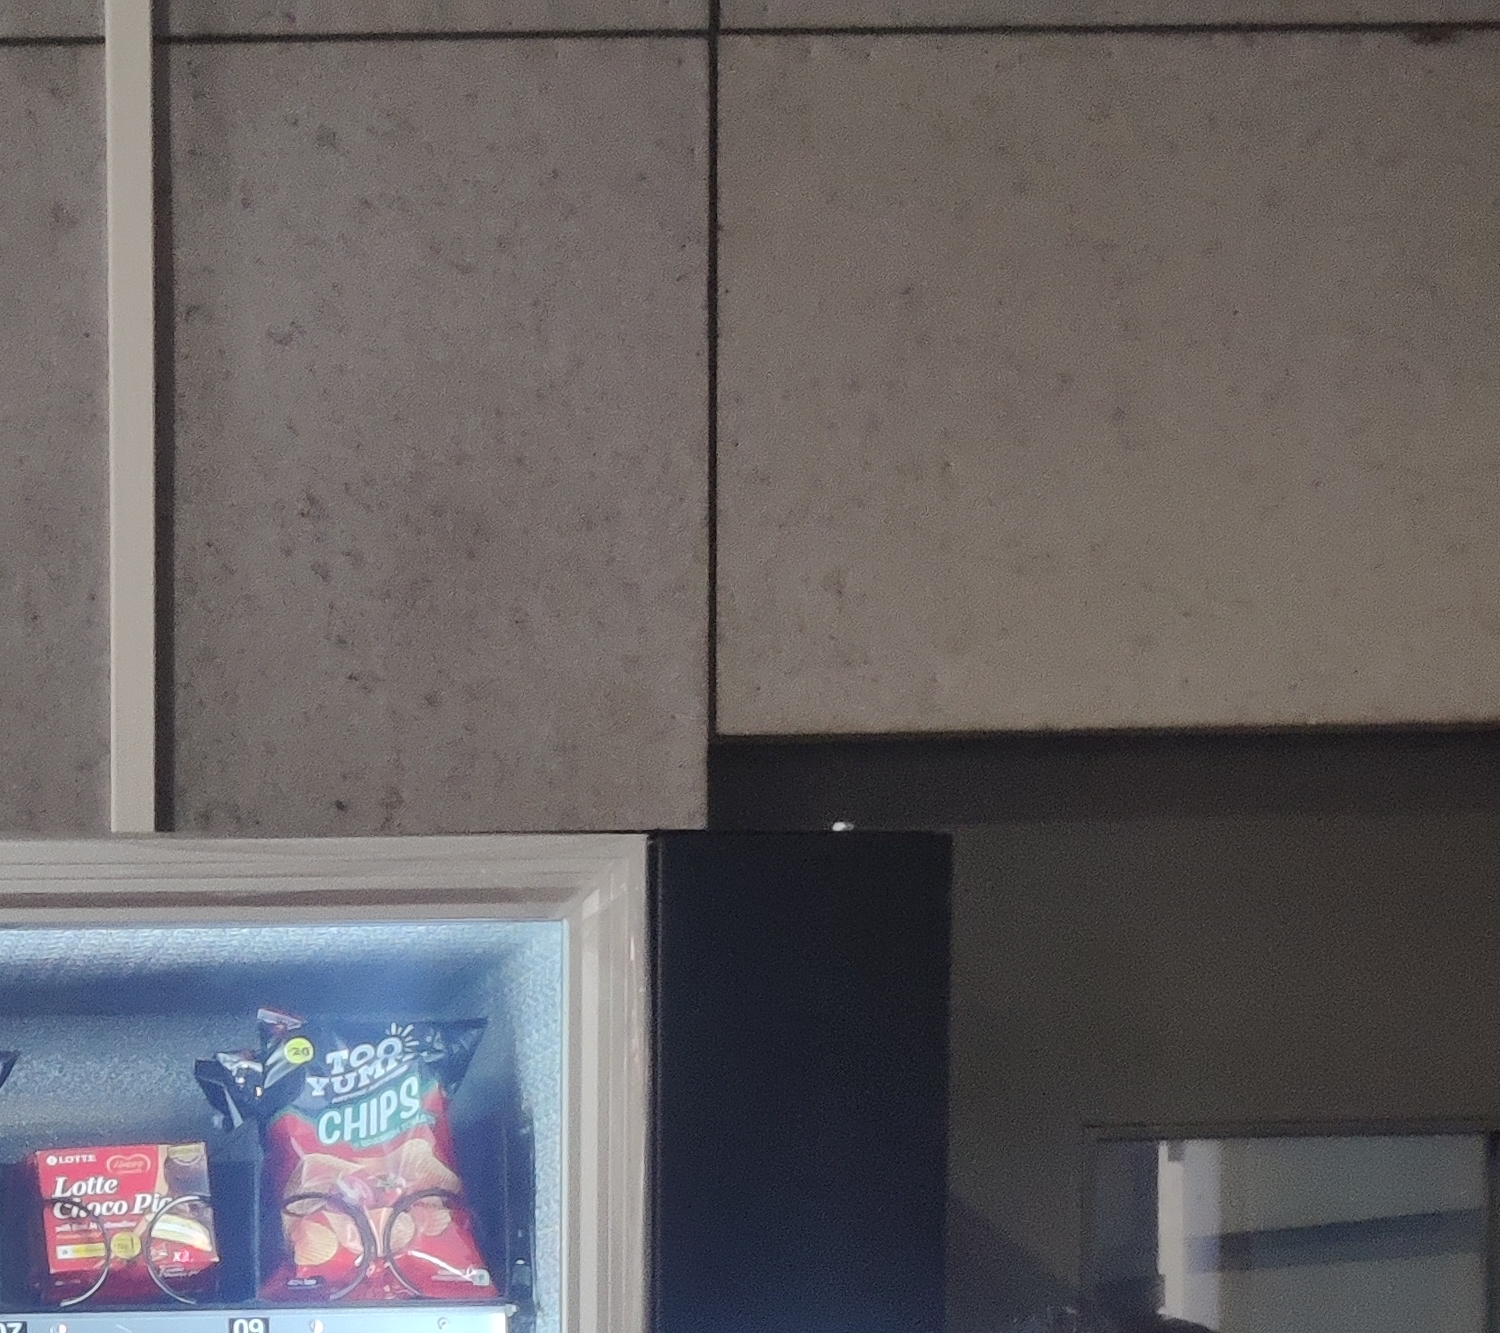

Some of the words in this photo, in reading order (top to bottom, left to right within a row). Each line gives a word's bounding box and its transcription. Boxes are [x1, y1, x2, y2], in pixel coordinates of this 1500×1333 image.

[326, 1037, 402, 1074] TOO
[318, 1077, 419, 1145] CHIPS
[58, 1154, 97, 1164] LOTTE
[52, 1176, 118, 1198] Lotte
